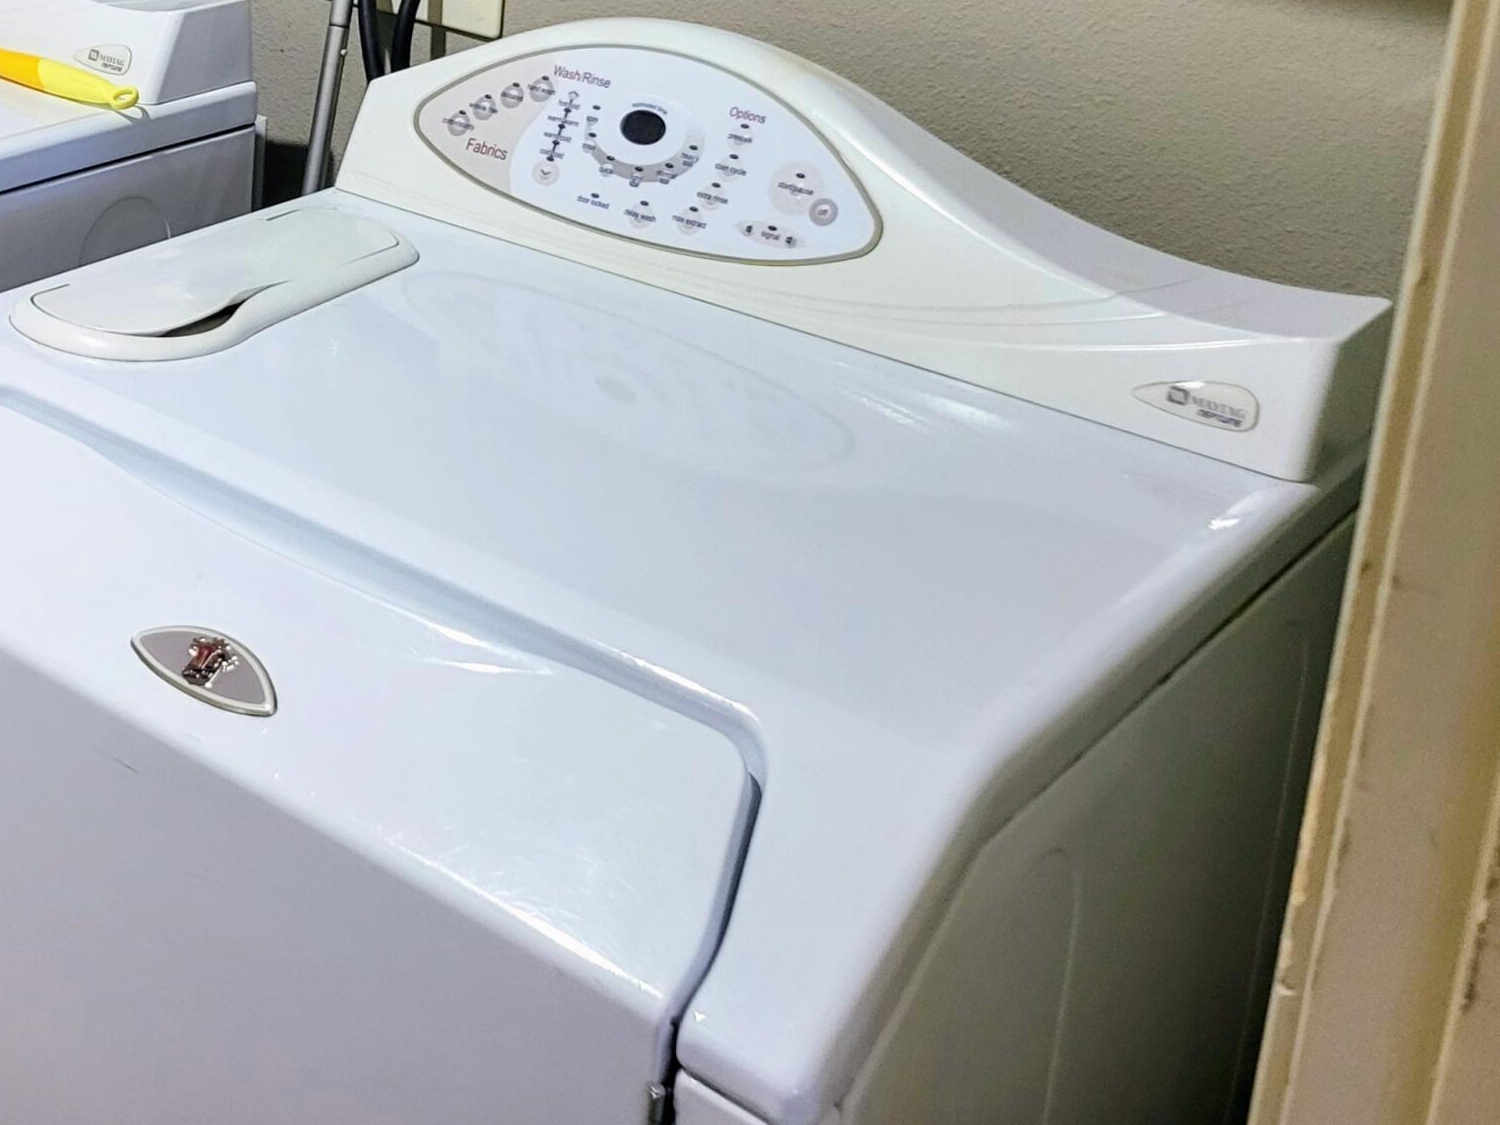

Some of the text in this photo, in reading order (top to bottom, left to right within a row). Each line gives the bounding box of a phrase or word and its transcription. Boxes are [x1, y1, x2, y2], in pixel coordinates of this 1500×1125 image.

[553, 65, 612, 89] Wash/Rinse
[729, 106, 766, 124] Options
[466, 137, 508, 161] Fabrics
